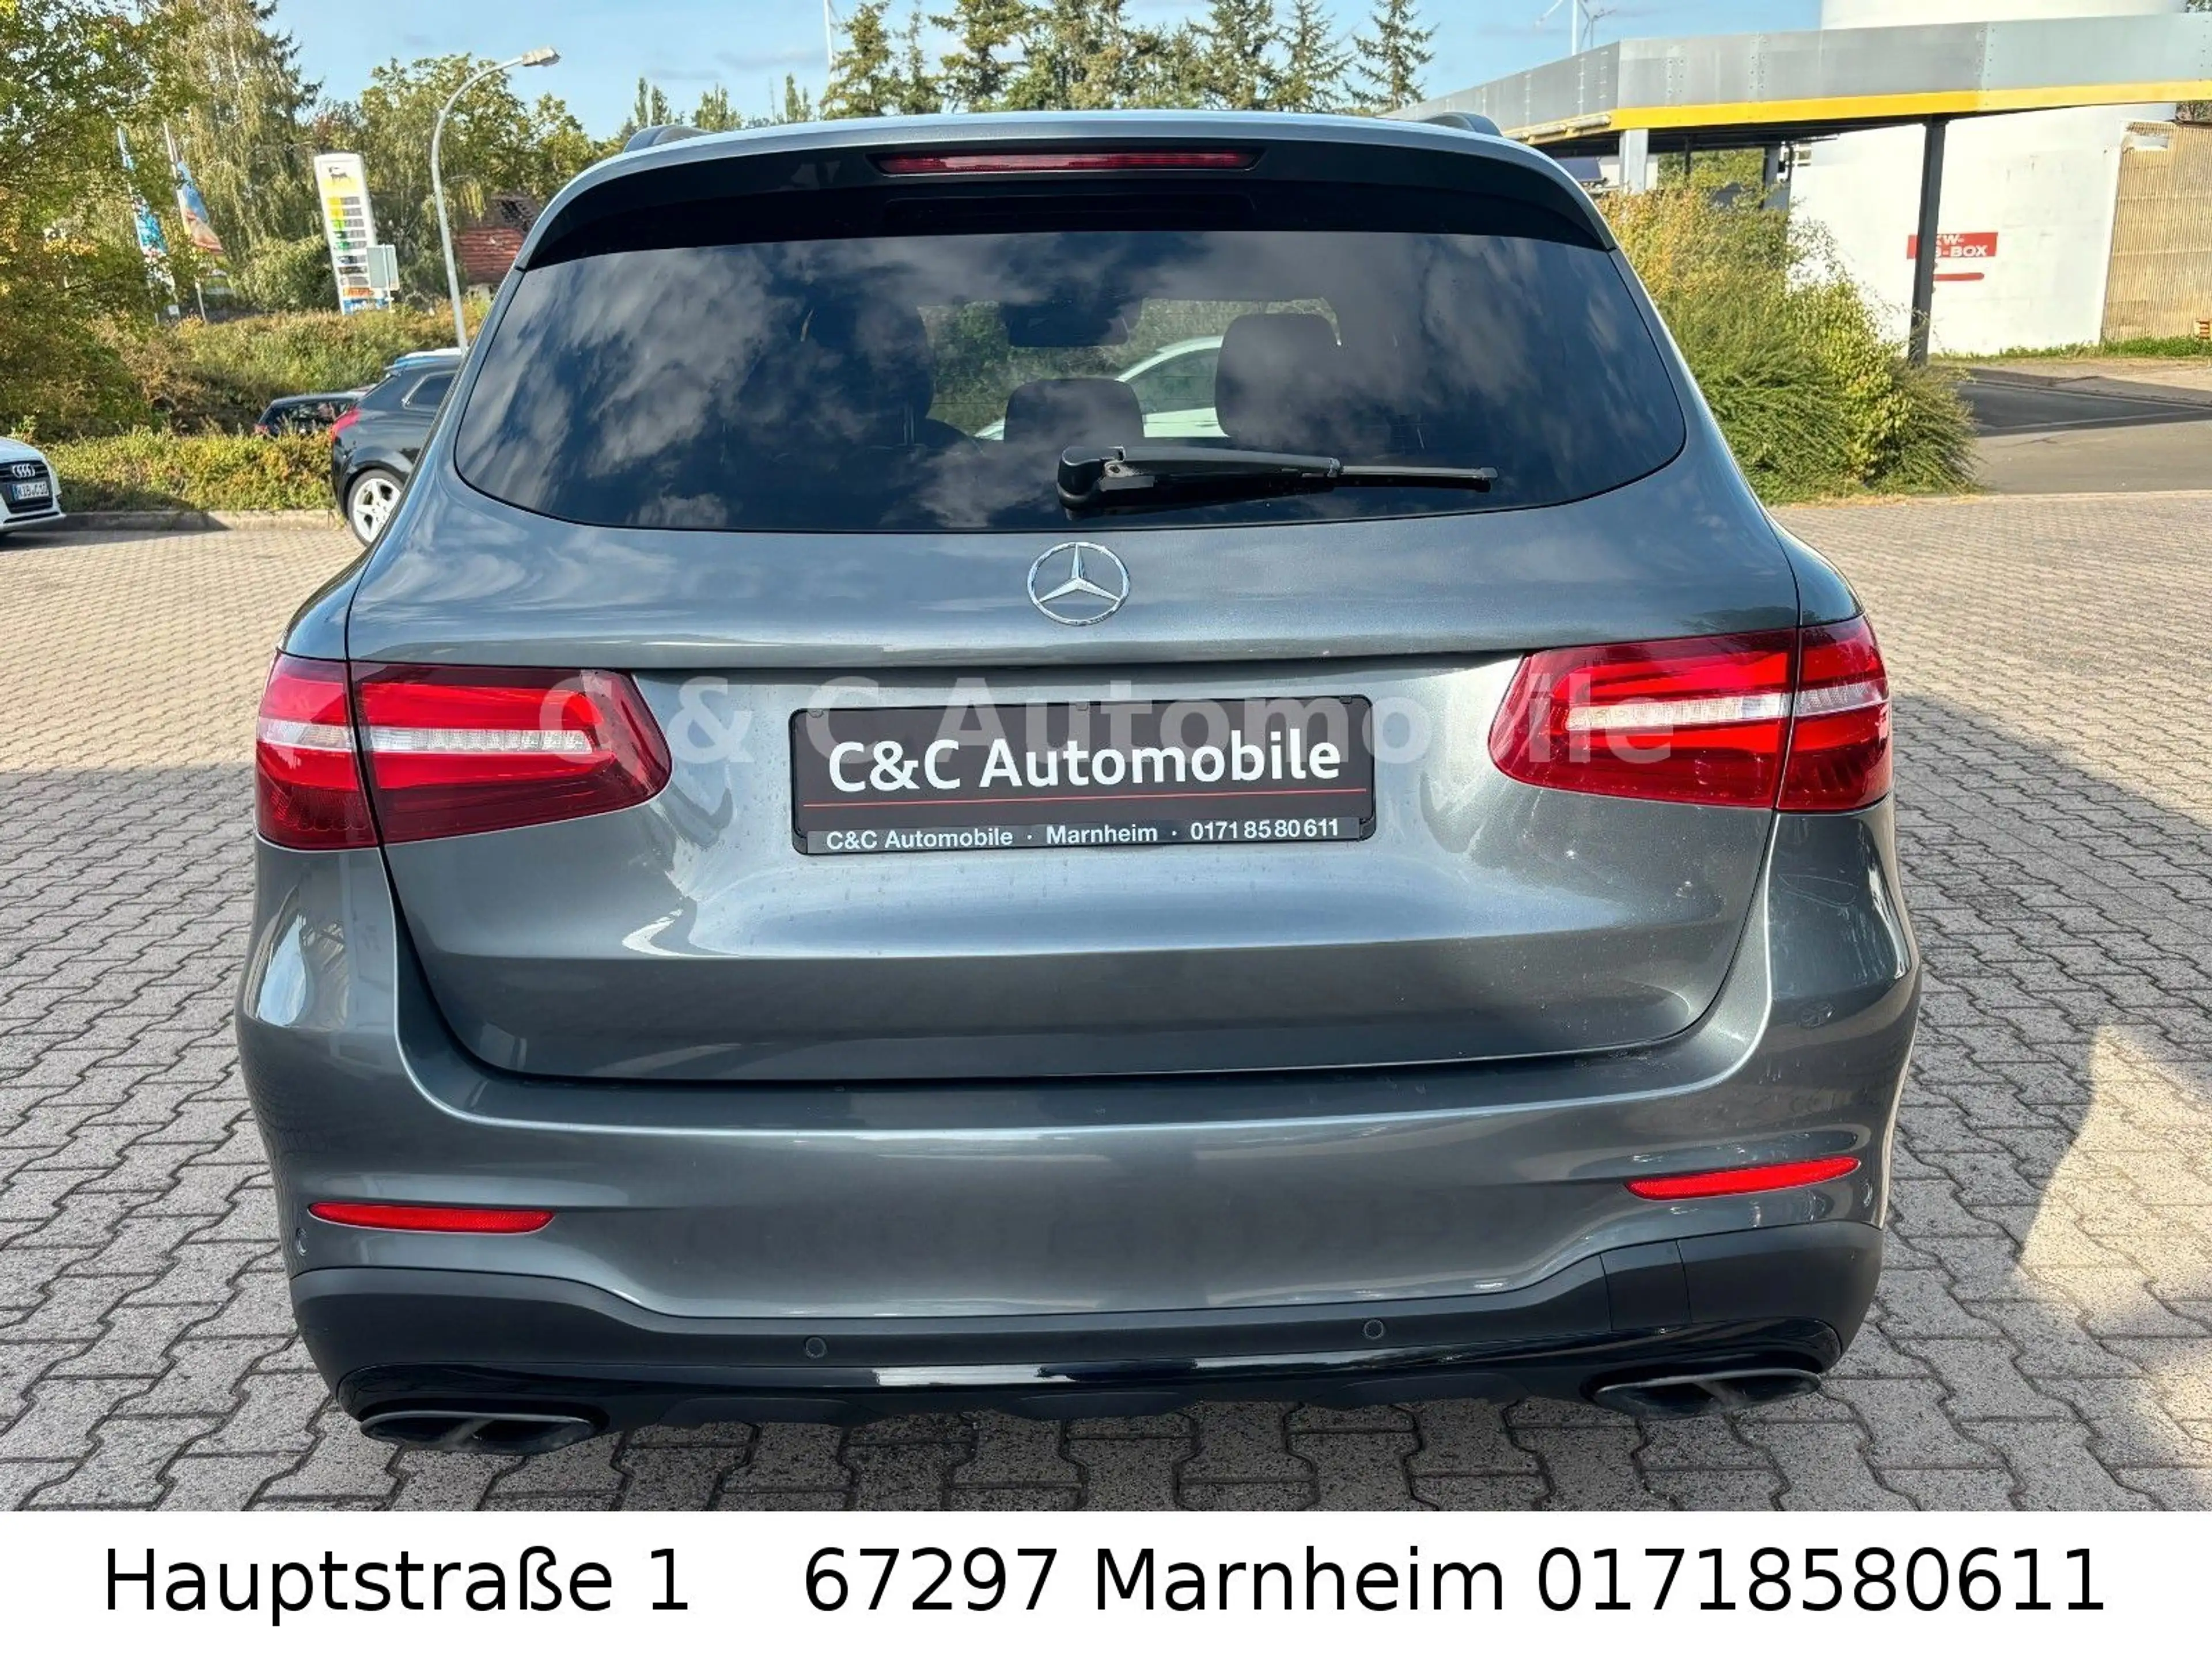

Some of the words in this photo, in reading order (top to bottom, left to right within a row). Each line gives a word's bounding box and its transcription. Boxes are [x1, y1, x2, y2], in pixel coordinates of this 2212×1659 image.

[830, 740, 960, 792] C&C
[979, 729, 1340, 787] Automobile
[827, 830, 877, 850] C&C
[884, 828, 1013, 849] Automobile
[1046, 824, 1158, 844] Marnheim
